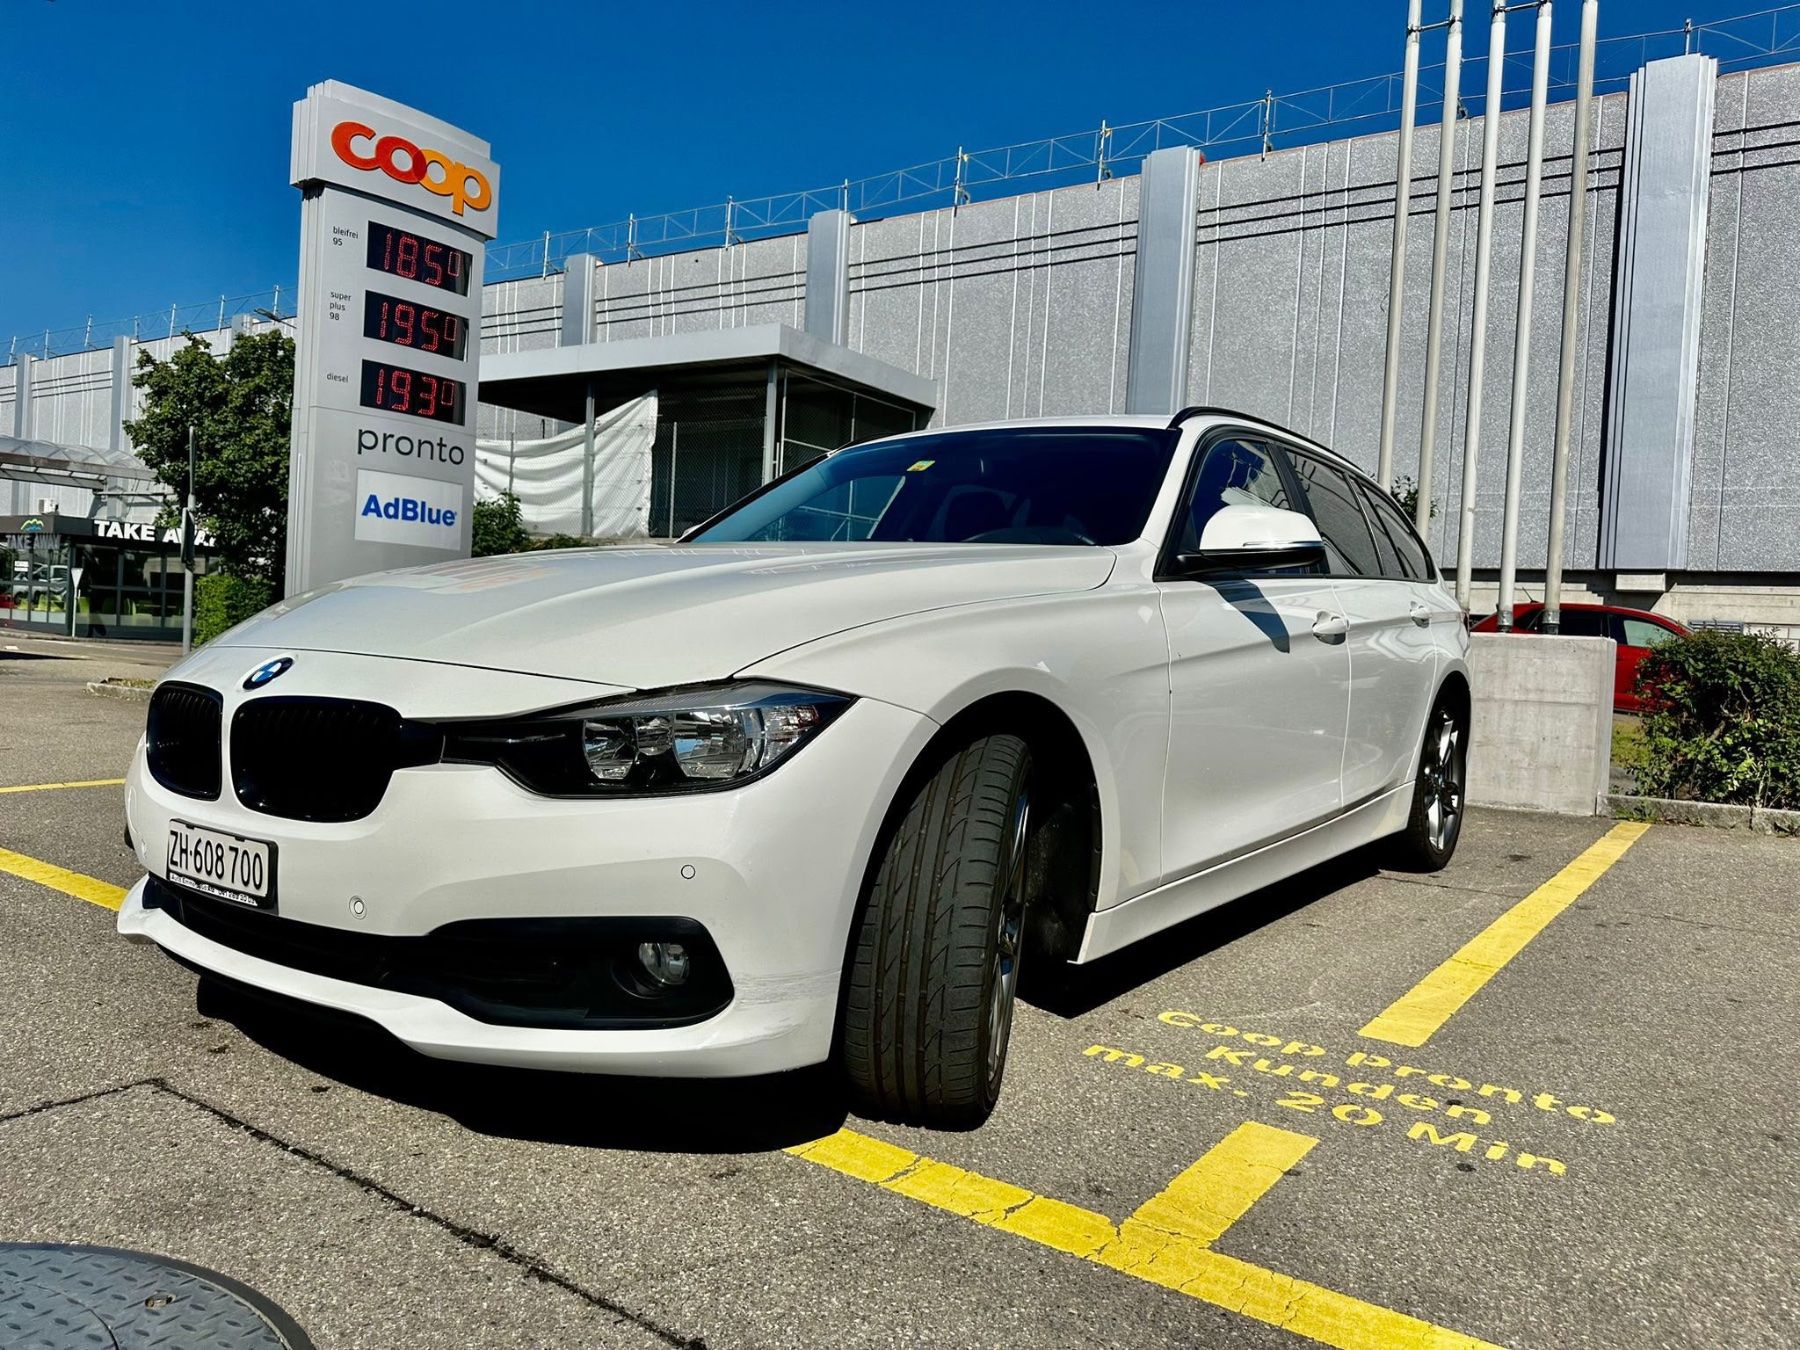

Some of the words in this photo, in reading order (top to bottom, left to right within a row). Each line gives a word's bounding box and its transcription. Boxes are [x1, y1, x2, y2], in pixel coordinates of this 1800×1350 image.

[331, 121, 492, 217] coop
[333, 226, 359, 239] bleifrei
[333, 237, 343, 246] 95
[330, 291, 351, 301] super
[329, 301, 346, 311] plus
[329, 312, 340, 321] 98
[326, 372, 349, 383] diesel
[357, 428, 465, 465] pronto
[94, 520, 156, 541] TAKE
[5, 533, 32, 550] TAKE
[1157, 1011, 1326, 1056] Coop
[1345, 1052, 1616, 1124] pronto
[1205, 1045, 1491, 1125] Kunden
[1082, 1044, 1247, 1097] max.
[1275, 1091, 1383, 1126] 20
[1406, 1121, 1567, 1176] Min
